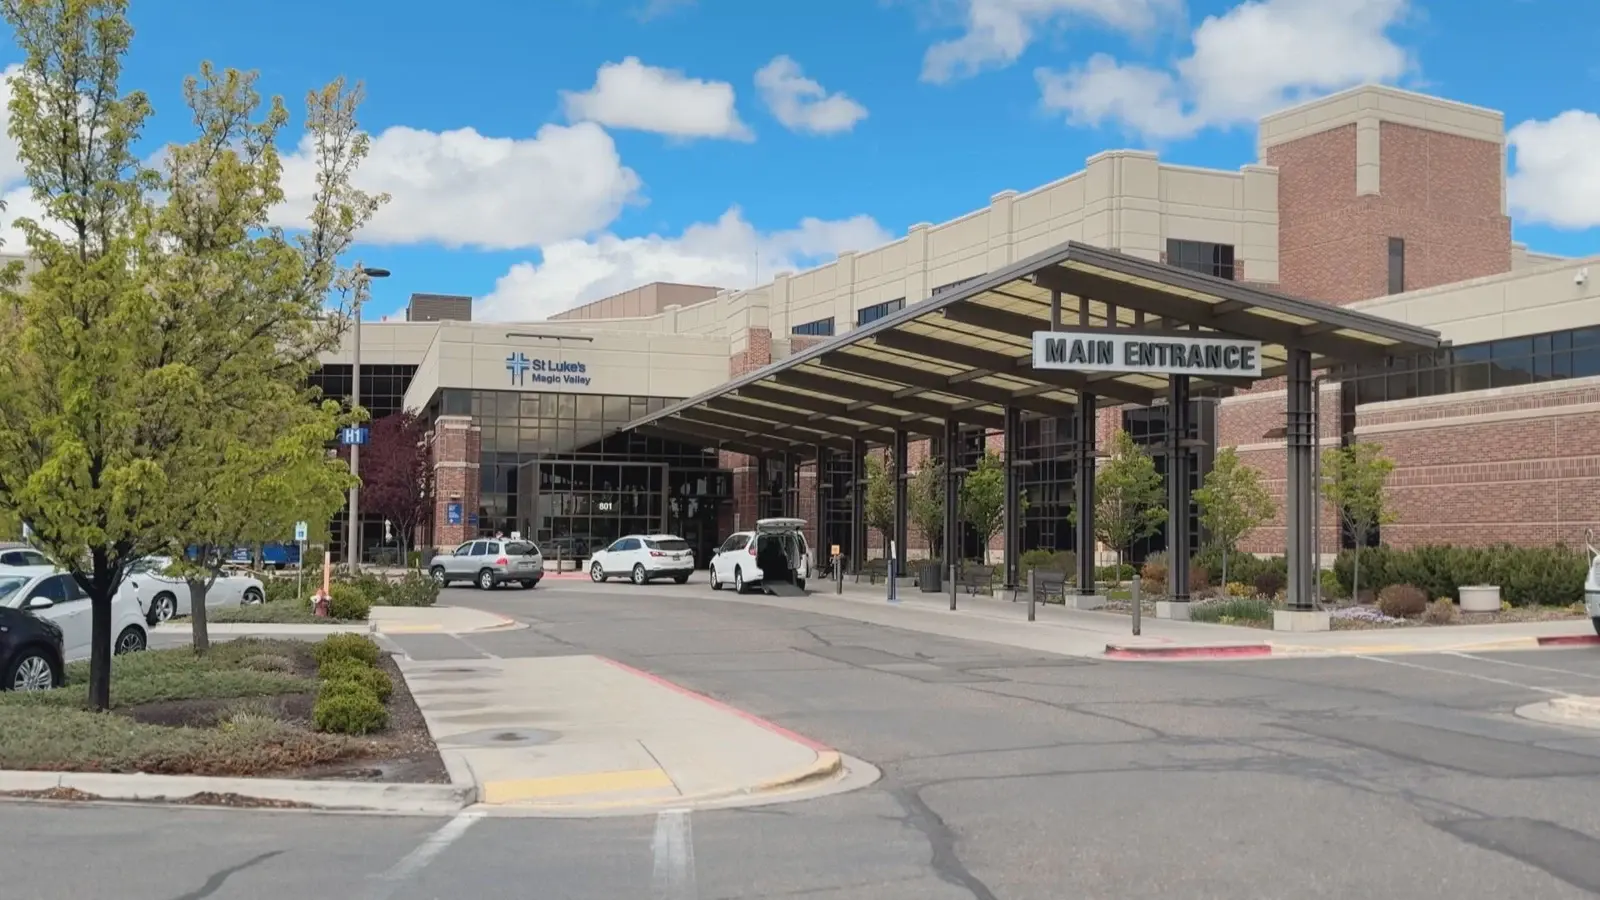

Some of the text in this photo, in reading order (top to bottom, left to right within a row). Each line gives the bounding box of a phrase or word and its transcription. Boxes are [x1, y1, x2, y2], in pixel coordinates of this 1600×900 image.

[1045, 338, 1255, 370] MAIN ENTRANCE
[532, 359, 586, 373] St Luke's
[532, 373, 591, 386] Magic Valley
[345, 429, 360, 443] H1
[599, 502, 612, 510] 801
